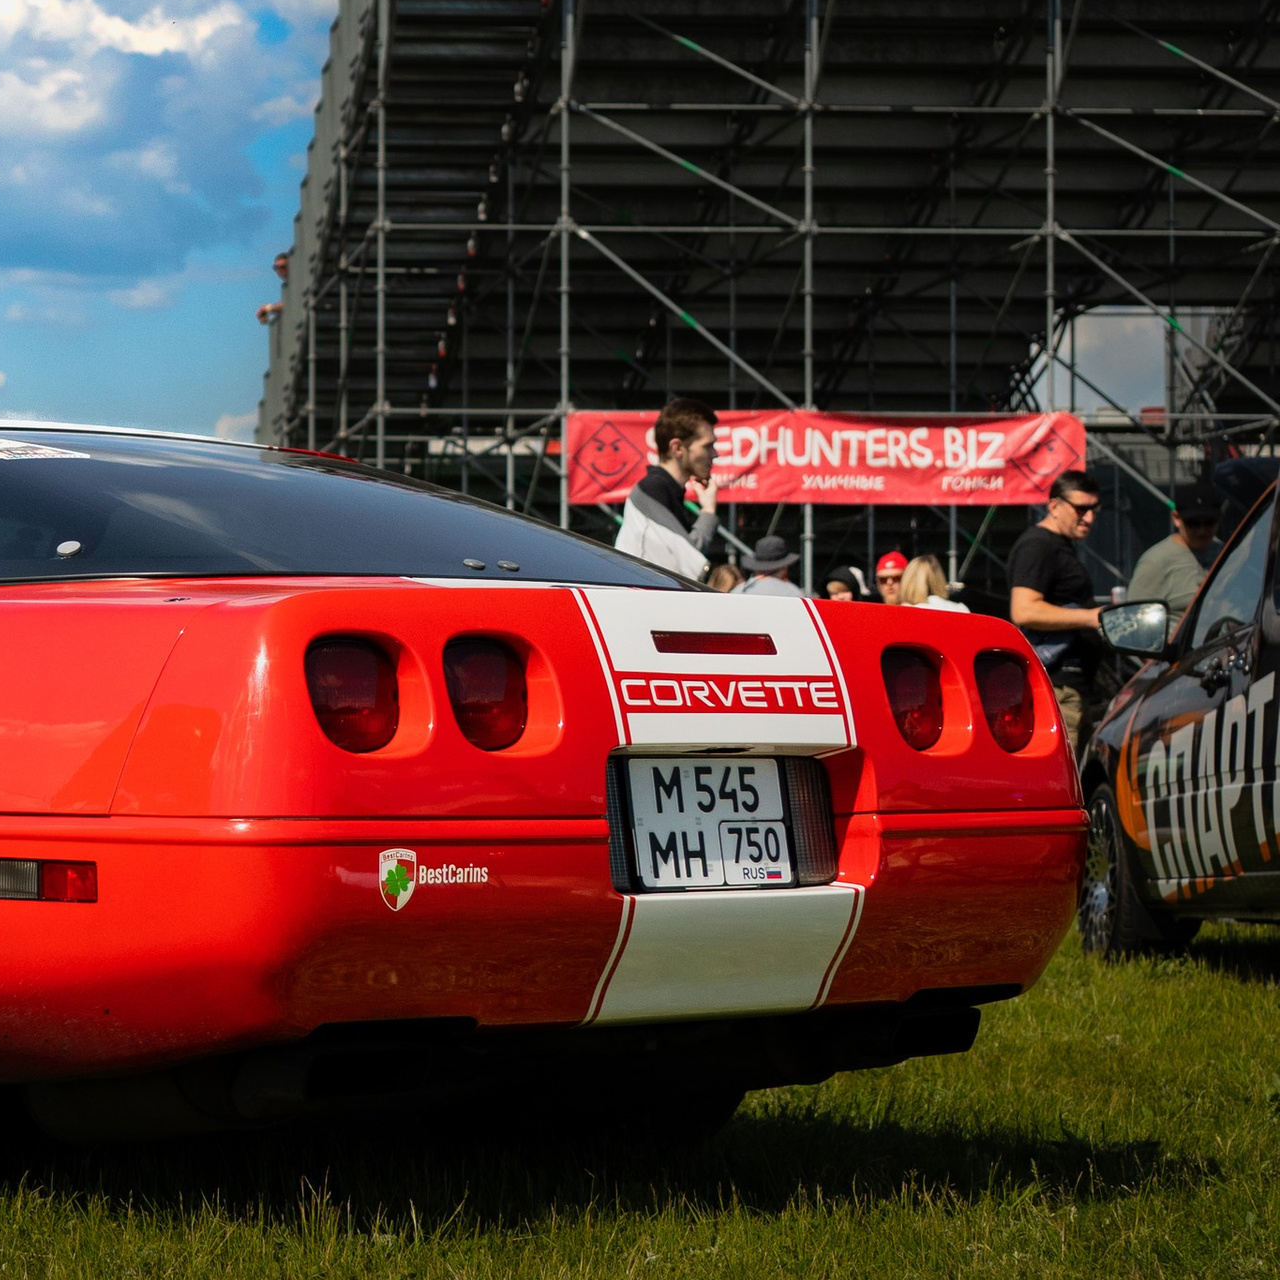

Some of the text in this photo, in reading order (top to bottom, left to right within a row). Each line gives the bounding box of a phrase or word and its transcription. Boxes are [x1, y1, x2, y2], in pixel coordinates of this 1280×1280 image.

[645, 425, 1006, 469] SEDHUNTERS.BIZ
[802, 475, 1004, 491] УЛИЧНЫЕ ГОНКИ
[620, 678, 839, 708] CORVETTE
[694, 766, 759, 813] 545
[1146, 671, 1280, 903] СПАРТ
[727, 827, 780, 864] 750
[418, 863, 489, 885] BestCarins
[742, 867, 766, 880] RUS
